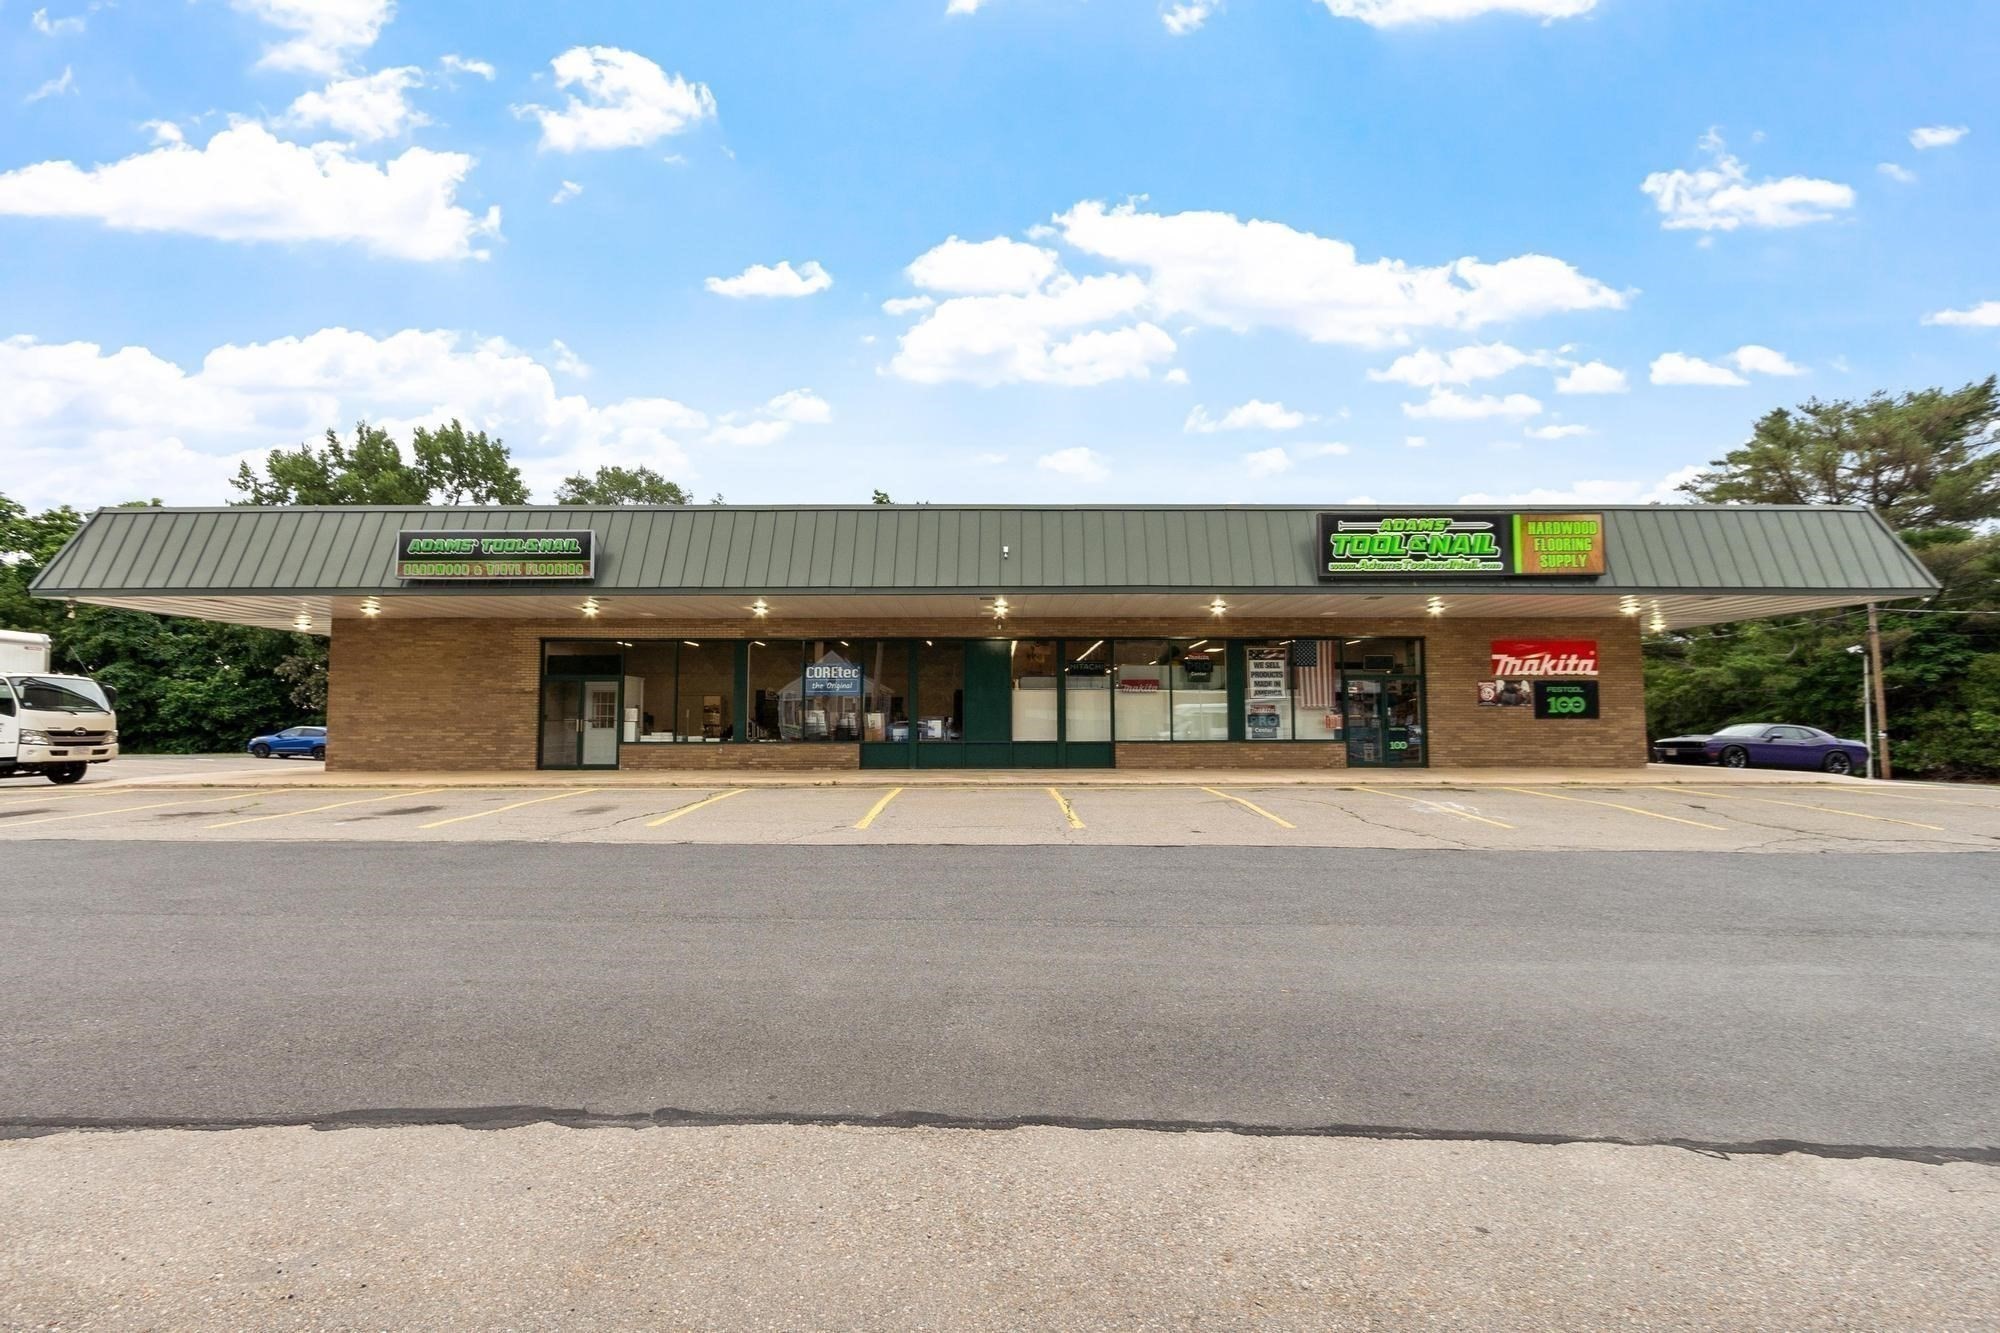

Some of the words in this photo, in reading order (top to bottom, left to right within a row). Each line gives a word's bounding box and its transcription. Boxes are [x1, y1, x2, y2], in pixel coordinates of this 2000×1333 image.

[1378, 518, 1453, 533] ADAMS'
[1527, 521, 1597, 535] HARDWOOD
[1534, 537, 1592, 552] FLOORING
[1539, 554, 1587, 569] SUPPLY
[403, 563, 469, 576] HARDWOOD
[474, 564, 483, 576] &
[487, 563, 521, 576] VINYL
[526, 563, 584, 576] FLOORING
[806, 666, 859, 678] COREtec
[826, 682, 853, 691] Original
[1248, 715, 1278, 726] PRO
